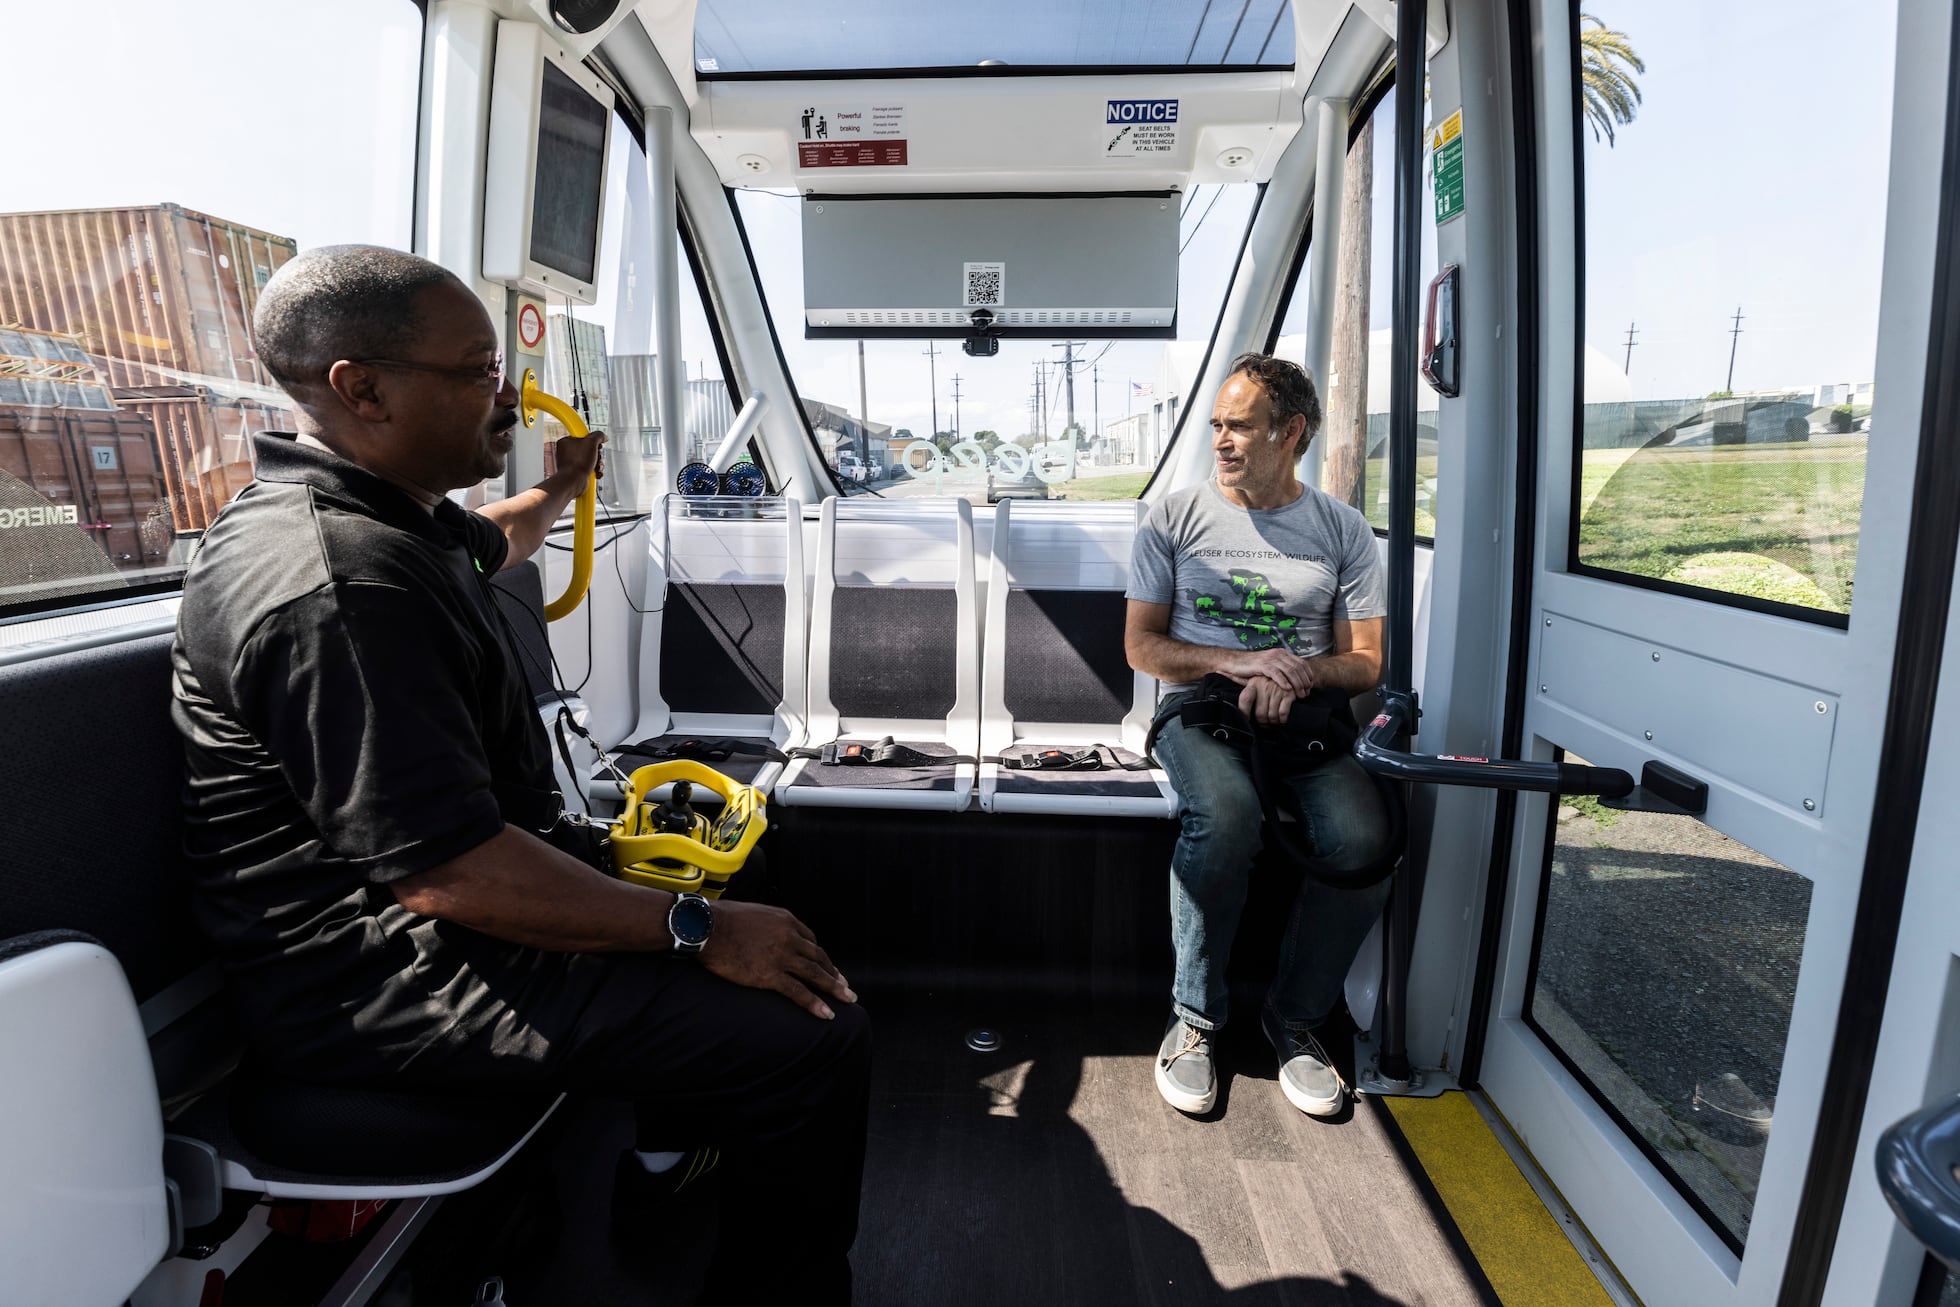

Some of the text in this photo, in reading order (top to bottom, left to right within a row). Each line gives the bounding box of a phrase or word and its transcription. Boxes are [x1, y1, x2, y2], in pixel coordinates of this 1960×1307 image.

[1108, 103, 1177, 120] NOTICE
[96, 451, 111, 465] 17
[1225, 549, 1281, 559] ECOSYSTEM
[1284, 552, 1326, 564] WILDLIFE
